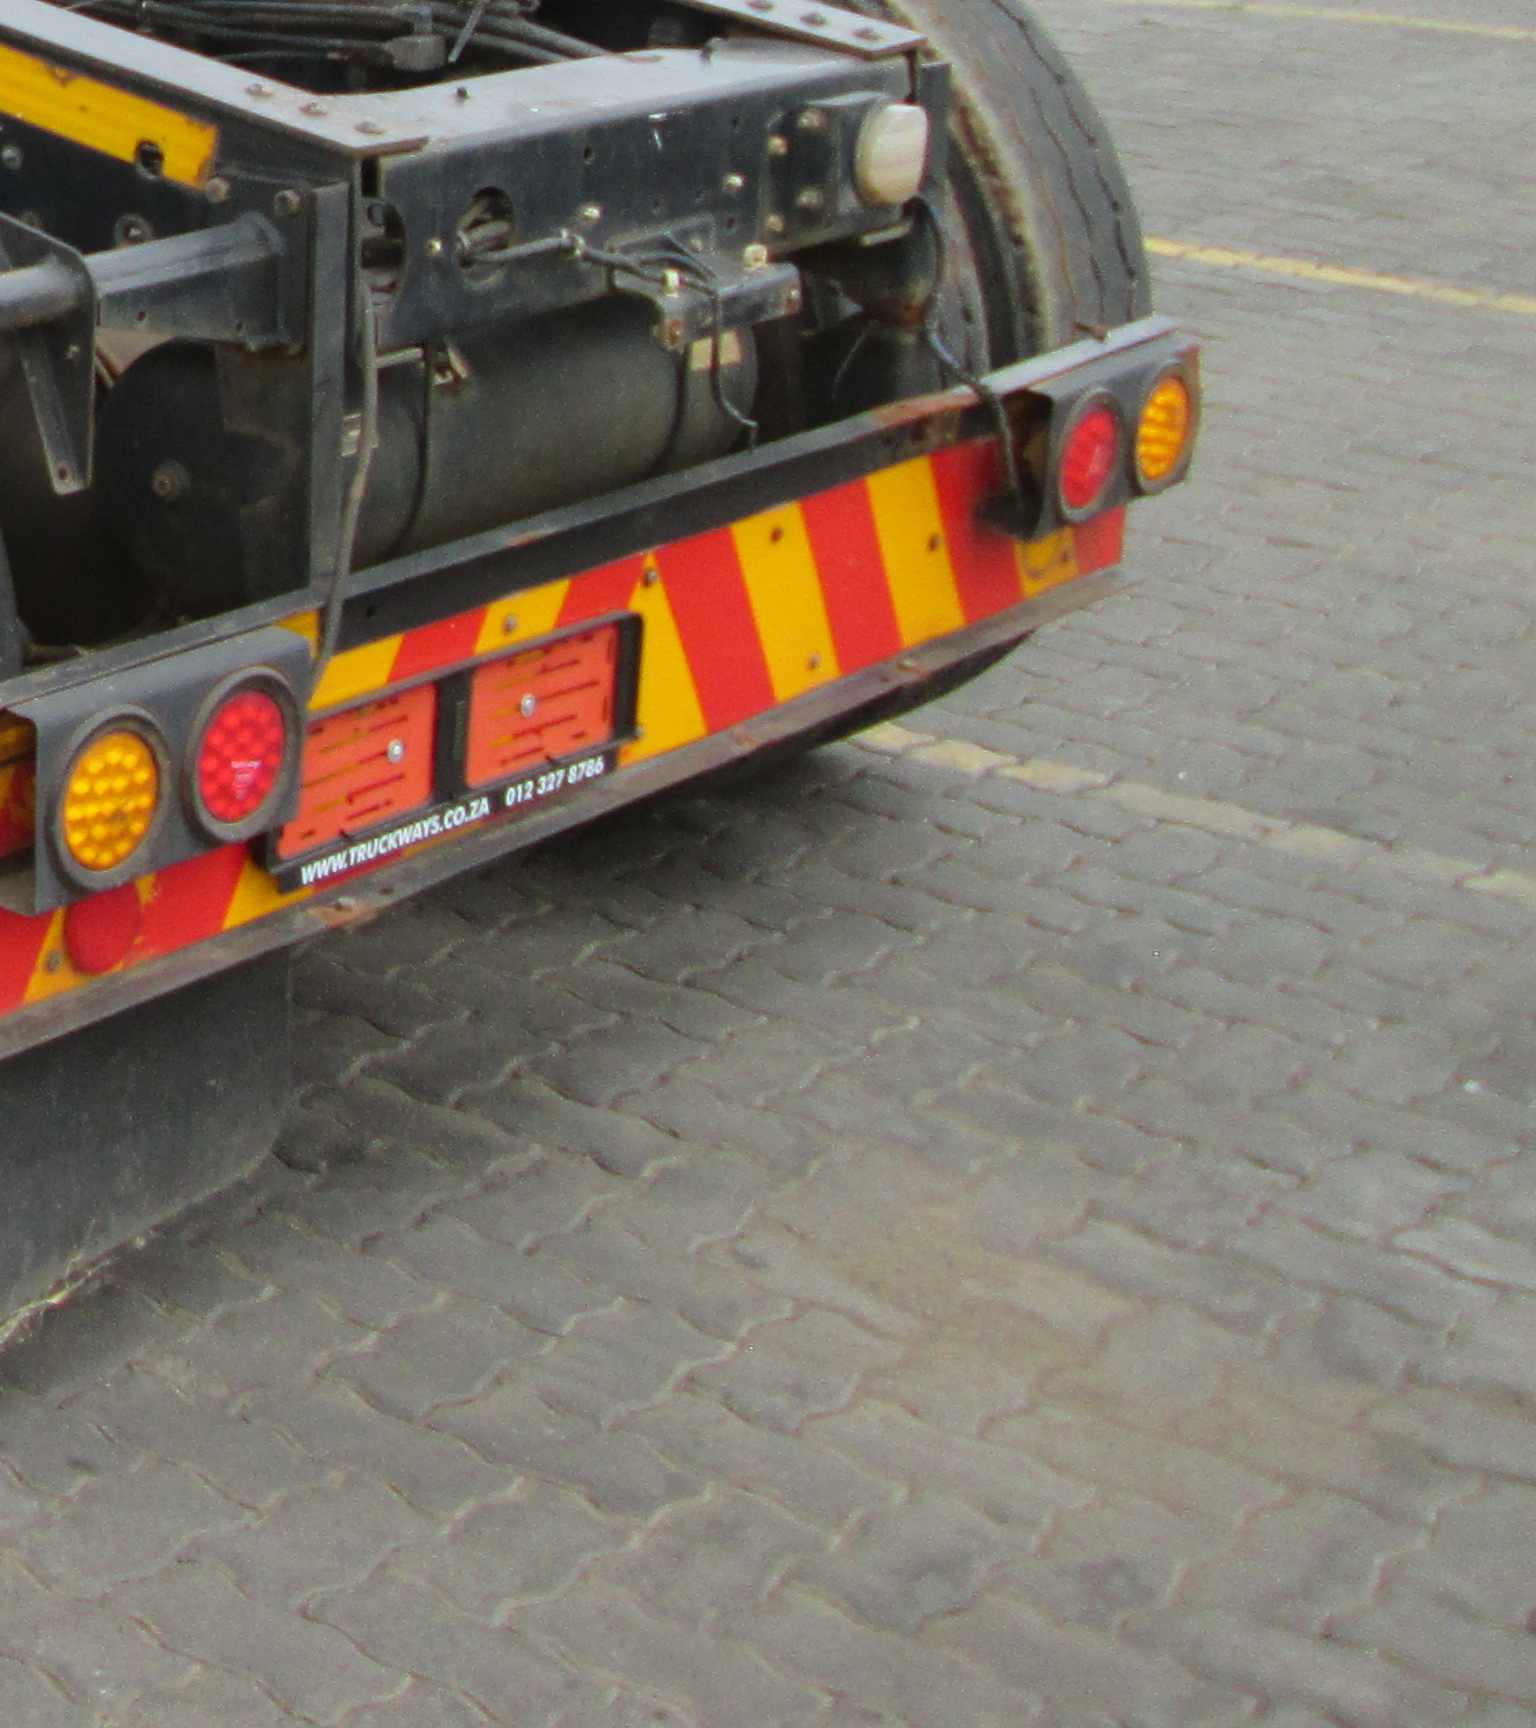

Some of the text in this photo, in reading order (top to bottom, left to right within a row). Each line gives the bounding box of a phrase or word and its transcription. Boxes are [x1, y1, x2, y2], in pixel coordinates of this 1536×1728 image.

[301, 796, 491, 885] WWW.TRUCKWAYS.CO.ZA
[505, 781, 534, 806] 012
[537, 769, 565, 796] 327
